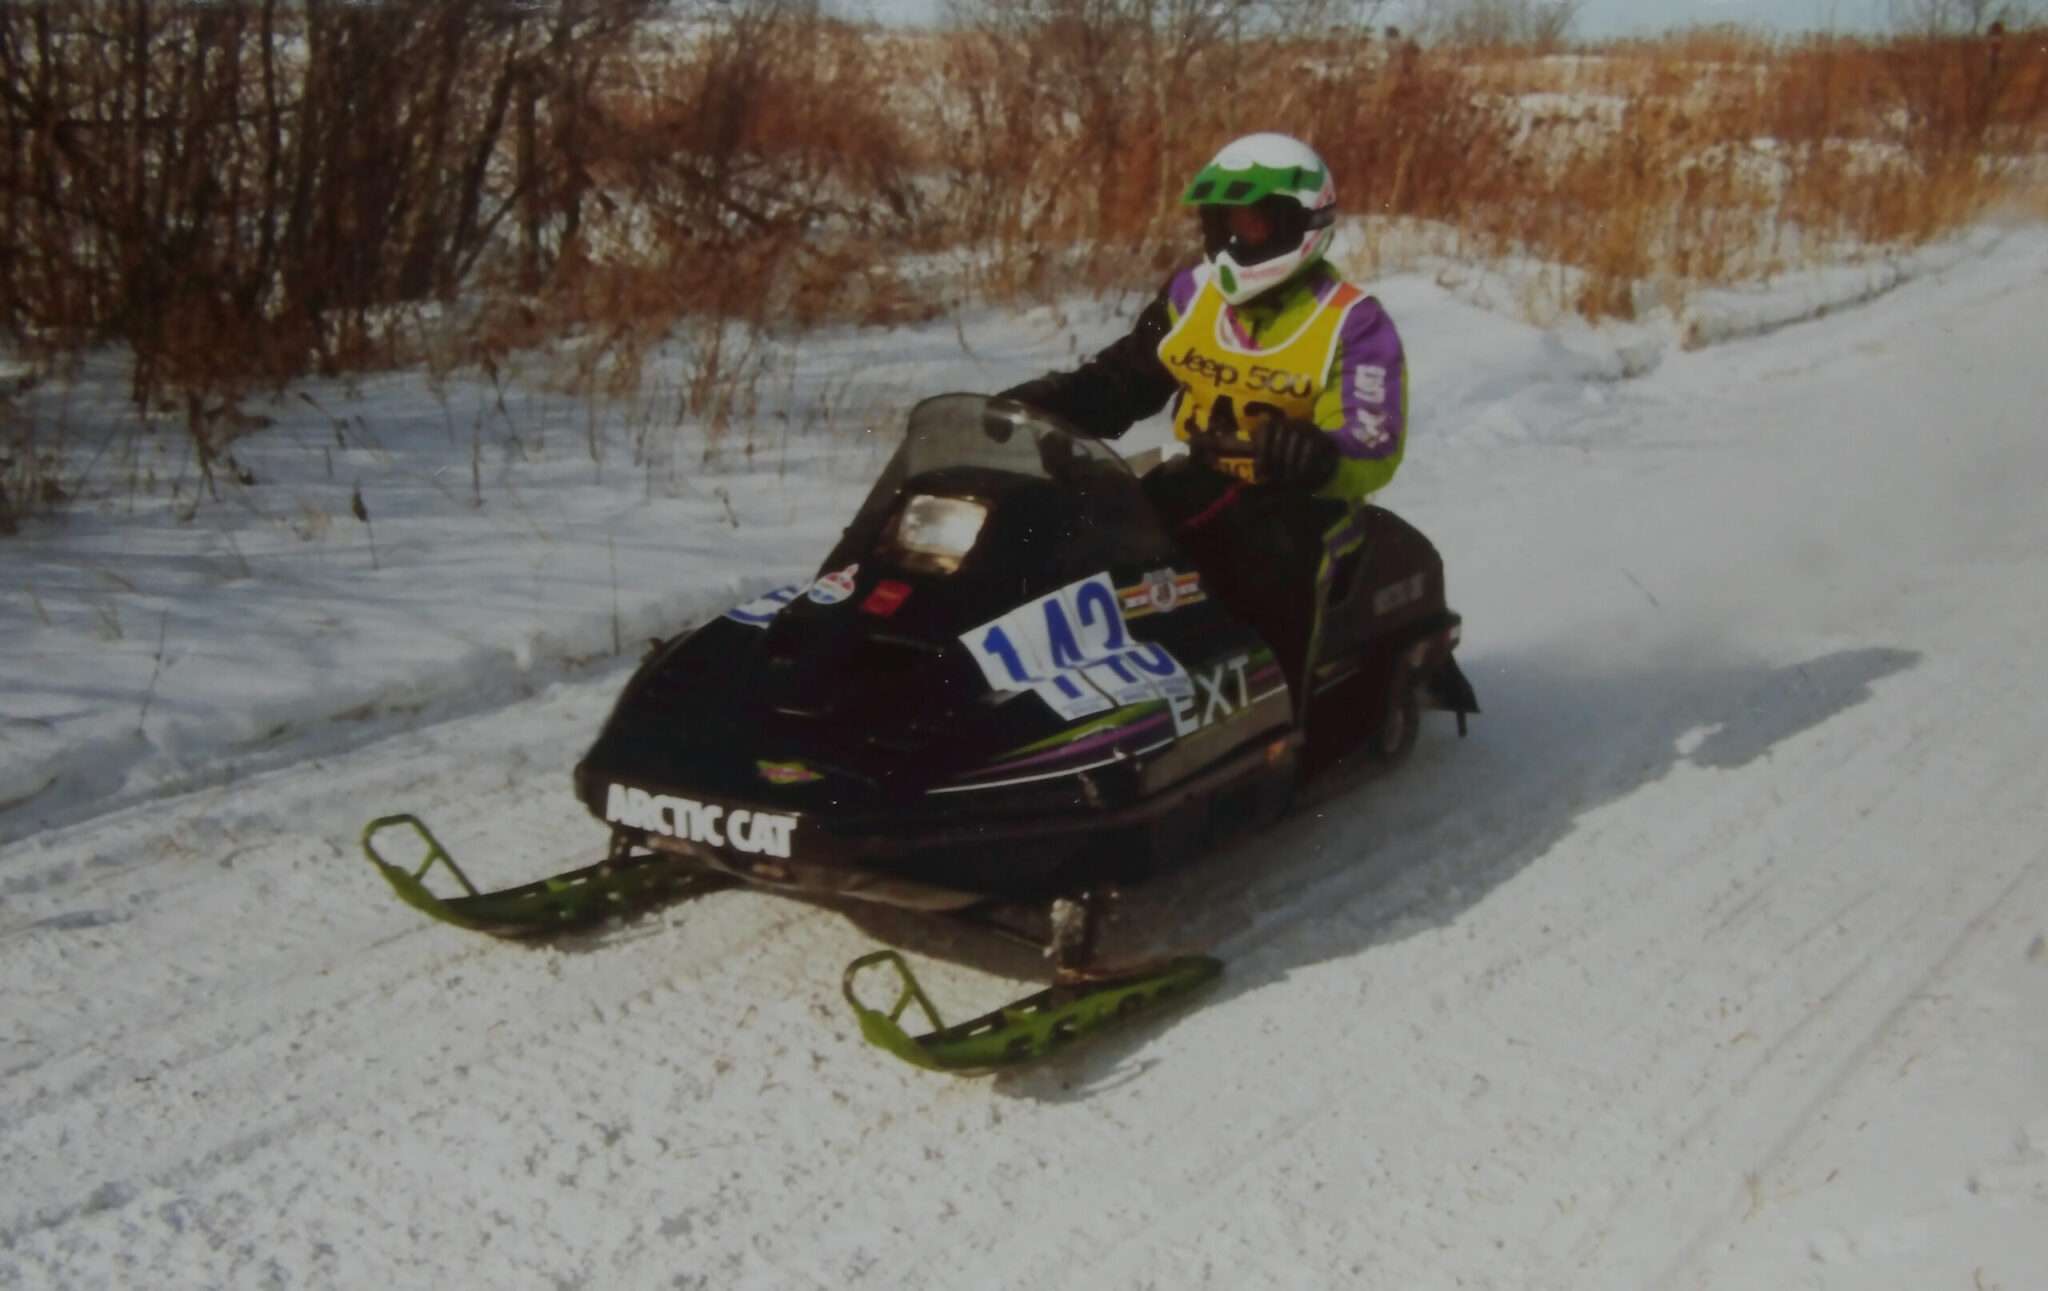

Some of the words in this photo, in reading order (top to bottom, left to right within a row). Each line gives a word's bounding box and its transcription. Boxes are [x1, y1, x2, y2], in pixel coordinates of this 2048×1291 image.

[1170, 347, 1238, 390] Jeep
[1245, 365, 1312, 399] 500
[1170, 654, 1250, 737] EXT
[606, 783, 725, 848] ARCTIC
[726, 808, 798, 859] CAT
